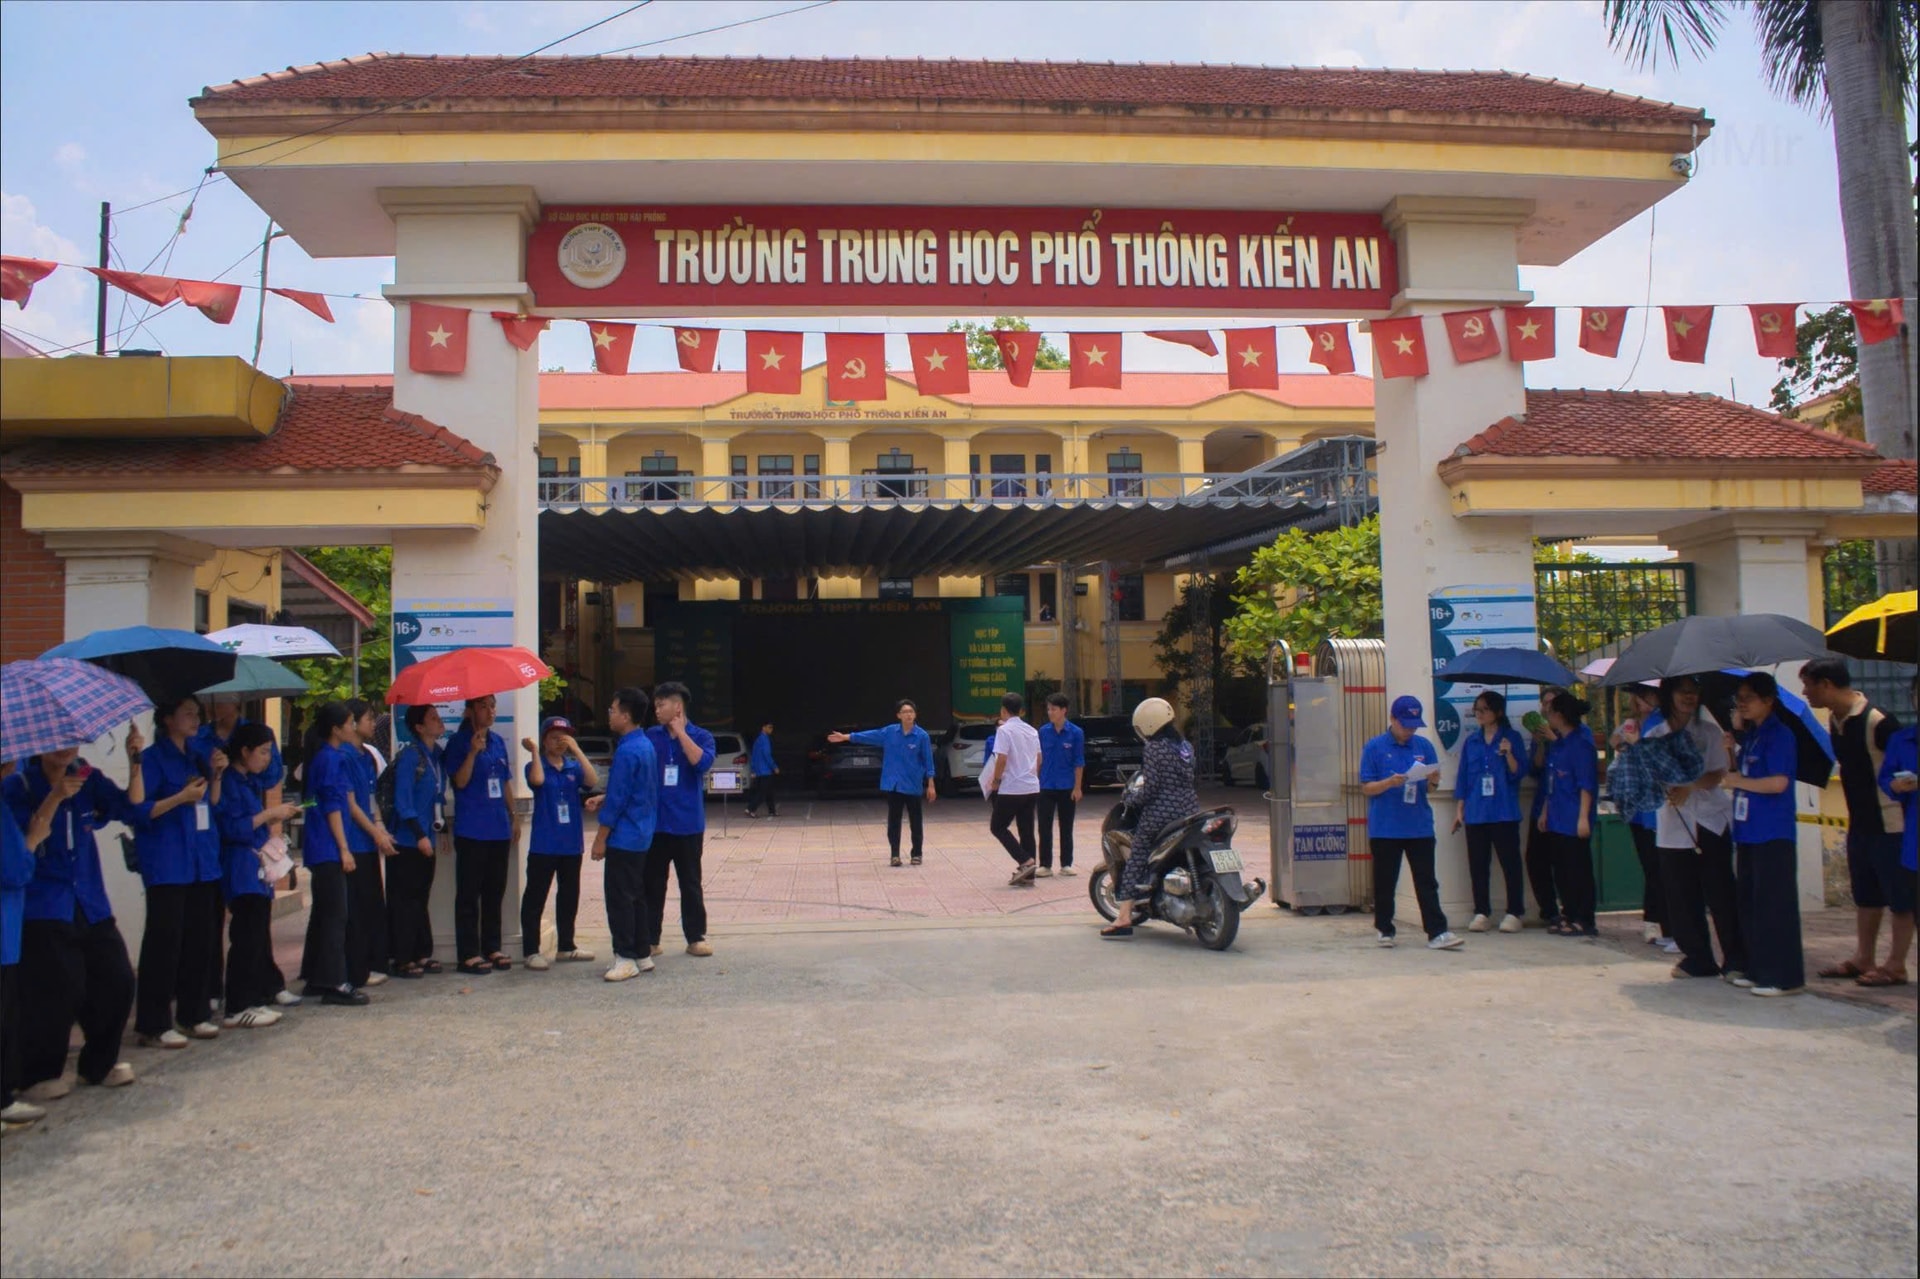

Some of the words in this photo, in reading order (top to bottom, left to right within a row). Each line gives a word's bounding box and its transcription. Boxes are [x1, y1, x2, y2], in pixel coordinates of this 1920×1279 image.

[654, 216, 806, 285] TRƯỜNG
[817, 227, 938, 285] TRUNG
[1031, 208, 1103, 287] PHỔ
[1111, 220, 1230, 288] THÔNG
[1239, 215, 1321, 289] KIẾN
[1332, 236, 1382, 290] AN
[931, 410, 948, 420] AN
[1430, 607, 1452, 620] 16+
[394, 621, 418, 636] 16+
[1438, 720, 1459, 733] 21+
